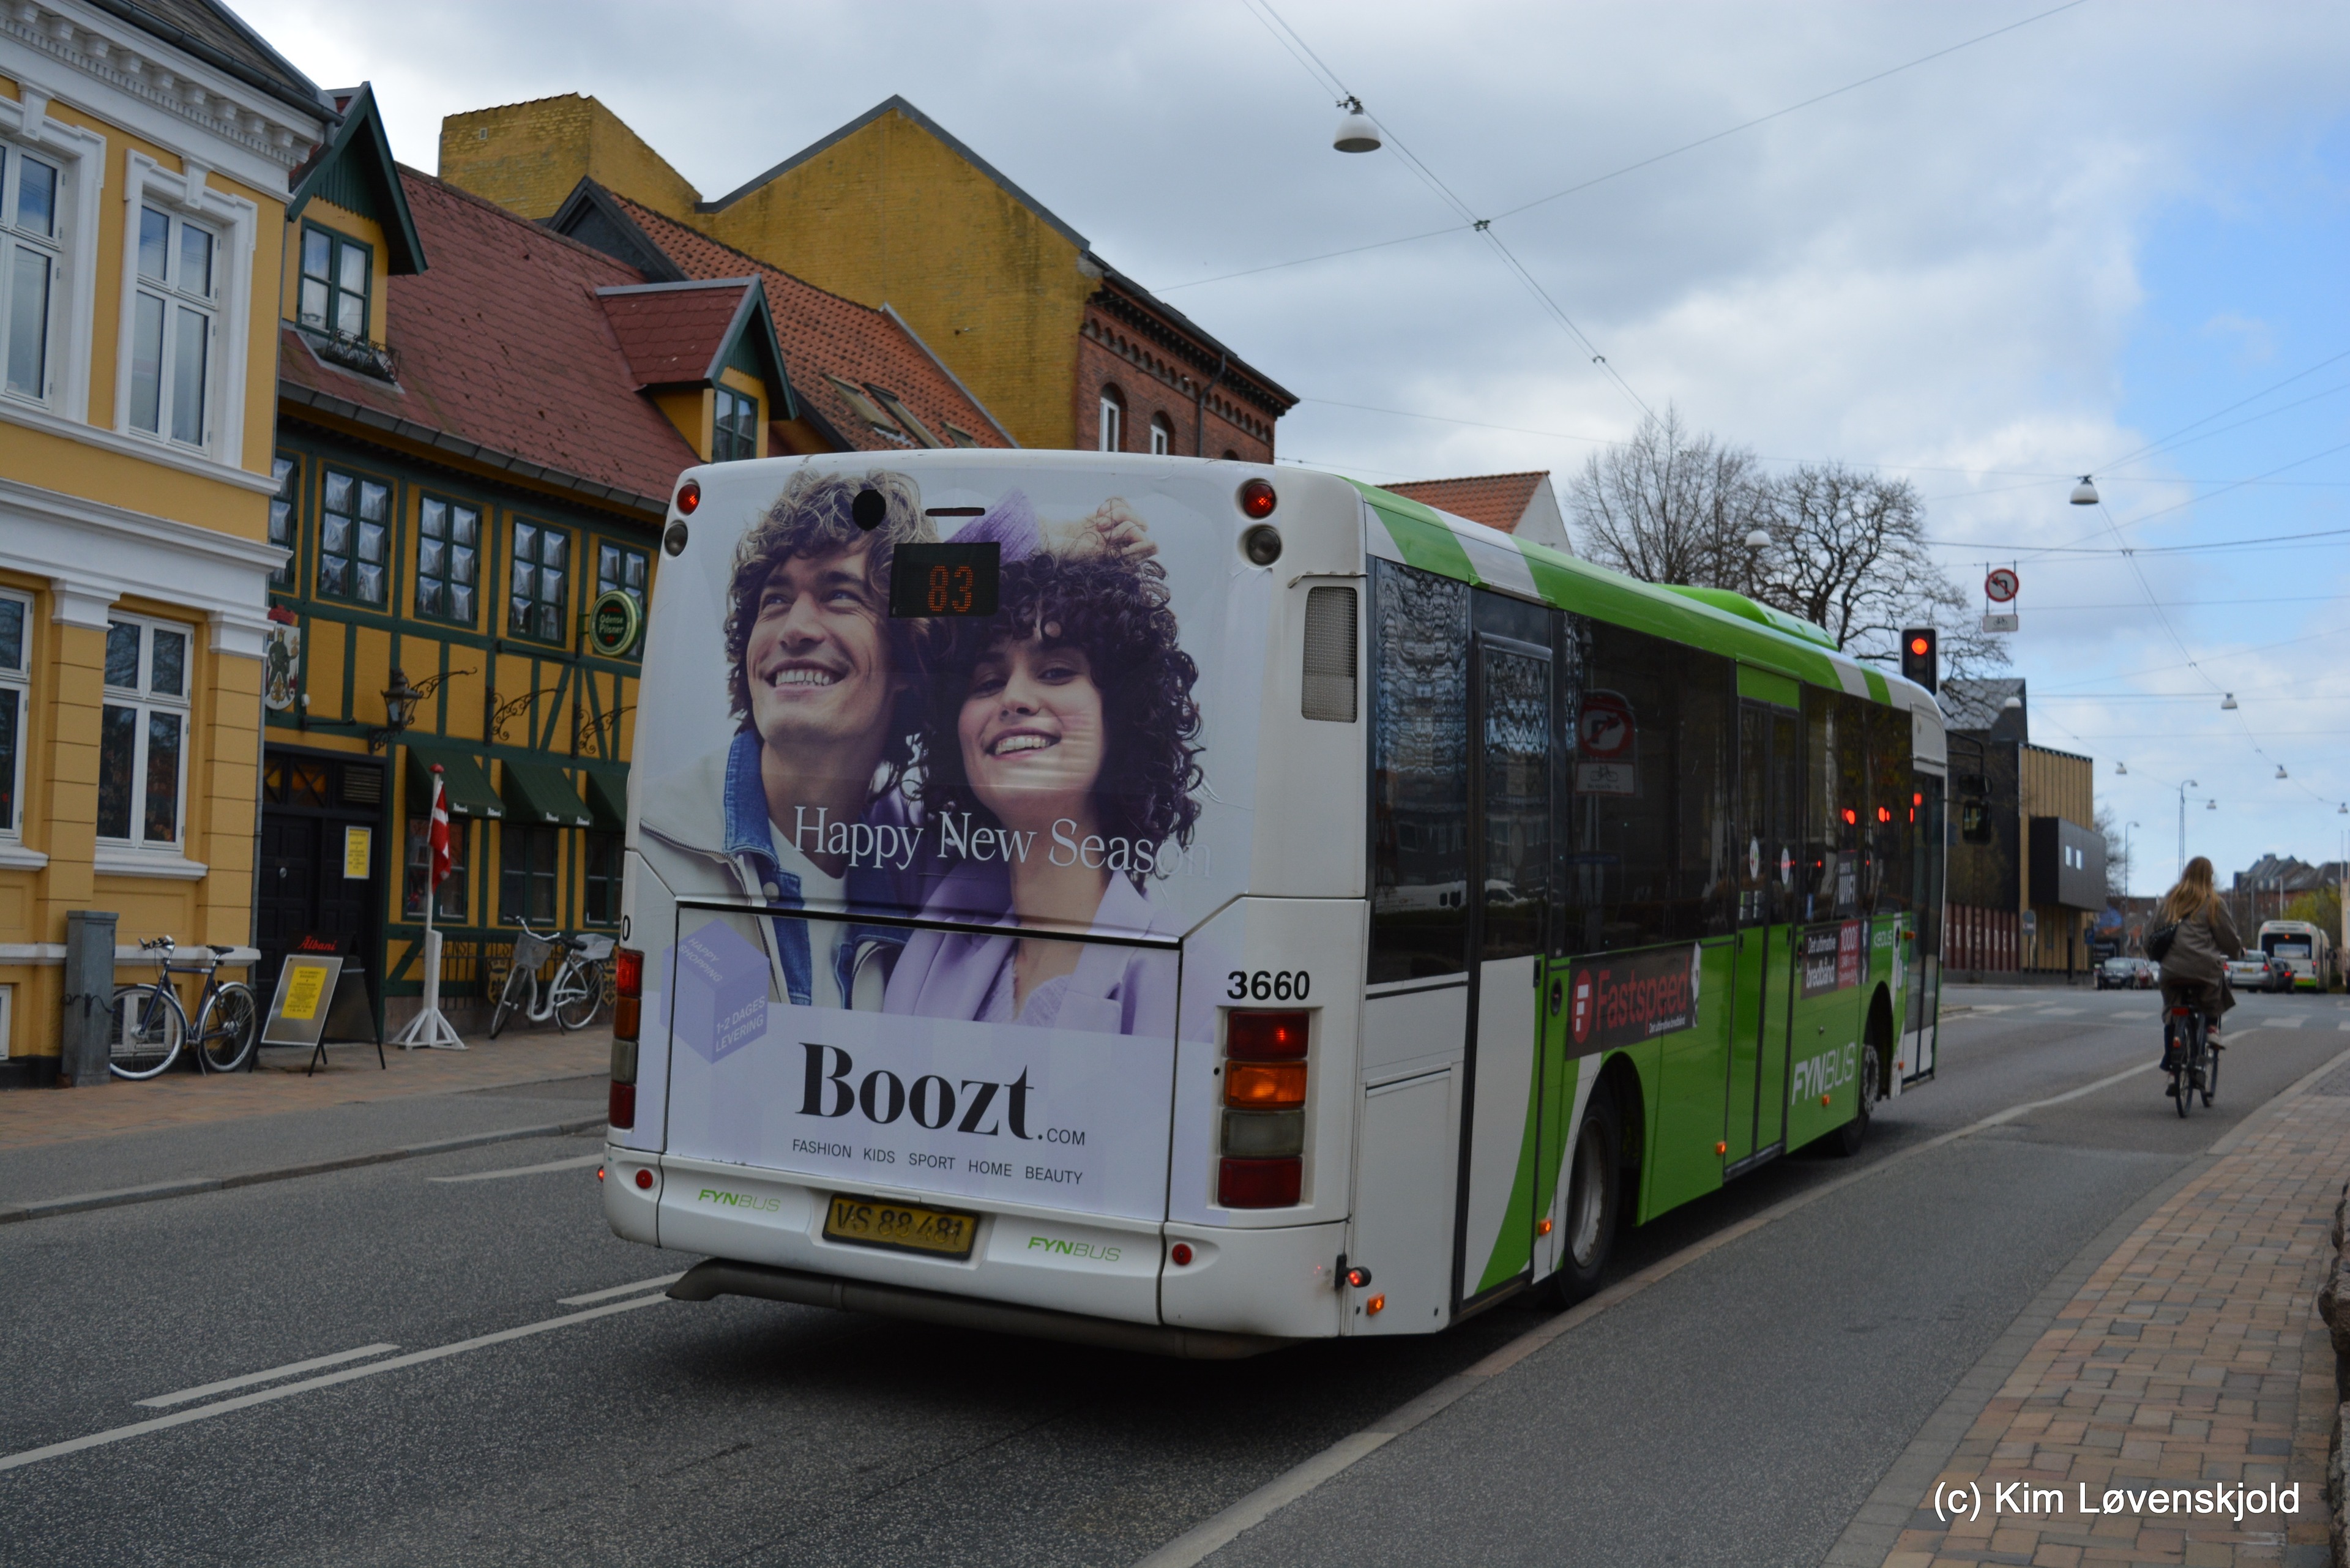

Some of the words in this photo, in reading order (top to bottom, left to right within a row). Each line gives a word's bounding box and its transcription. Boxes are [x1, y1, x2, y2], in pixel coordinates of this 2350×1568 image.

[928, 566, 973, 611] 83
[599, 624, 624, 633] Pilsner
[600, 614, 623, 624] Odense
[794, 805, 923, 870] Happy
[938, 811, 1038, 863] New
[1049, 818, 1213, 879] Season
[677, 944, 723, 982] SHOPPING
[688, 938, 720, 963] HAPPY
[1226, 970, 1310, 1001] 3660
[1806, 956, 1835, 988] bredbånd
[1595, 954, 1690, 1036] Fastspeed
[717, 1017, 730, 1034] 1-2
[733, 996, 765, 1025] DAGES
[715, 1014, 764, 1052] LEVERING
[1791, 1042, 1856, 1105] FYNBUS
[793, 1139, 852, 1158] FASHION
[864, 1148, 895, 1163] KIDS
[909, 1153, 956, 1170] SPORT
[968, 1160, 1012, 1177] HOME
[1025, 1166, 1083, 1185] BEAUTY
[698, 1189, 781, 1212] FYNBUS
[837, 1203, 871, 1233] VS
[1028, 1236, 1121, 1262] FYNBUS
